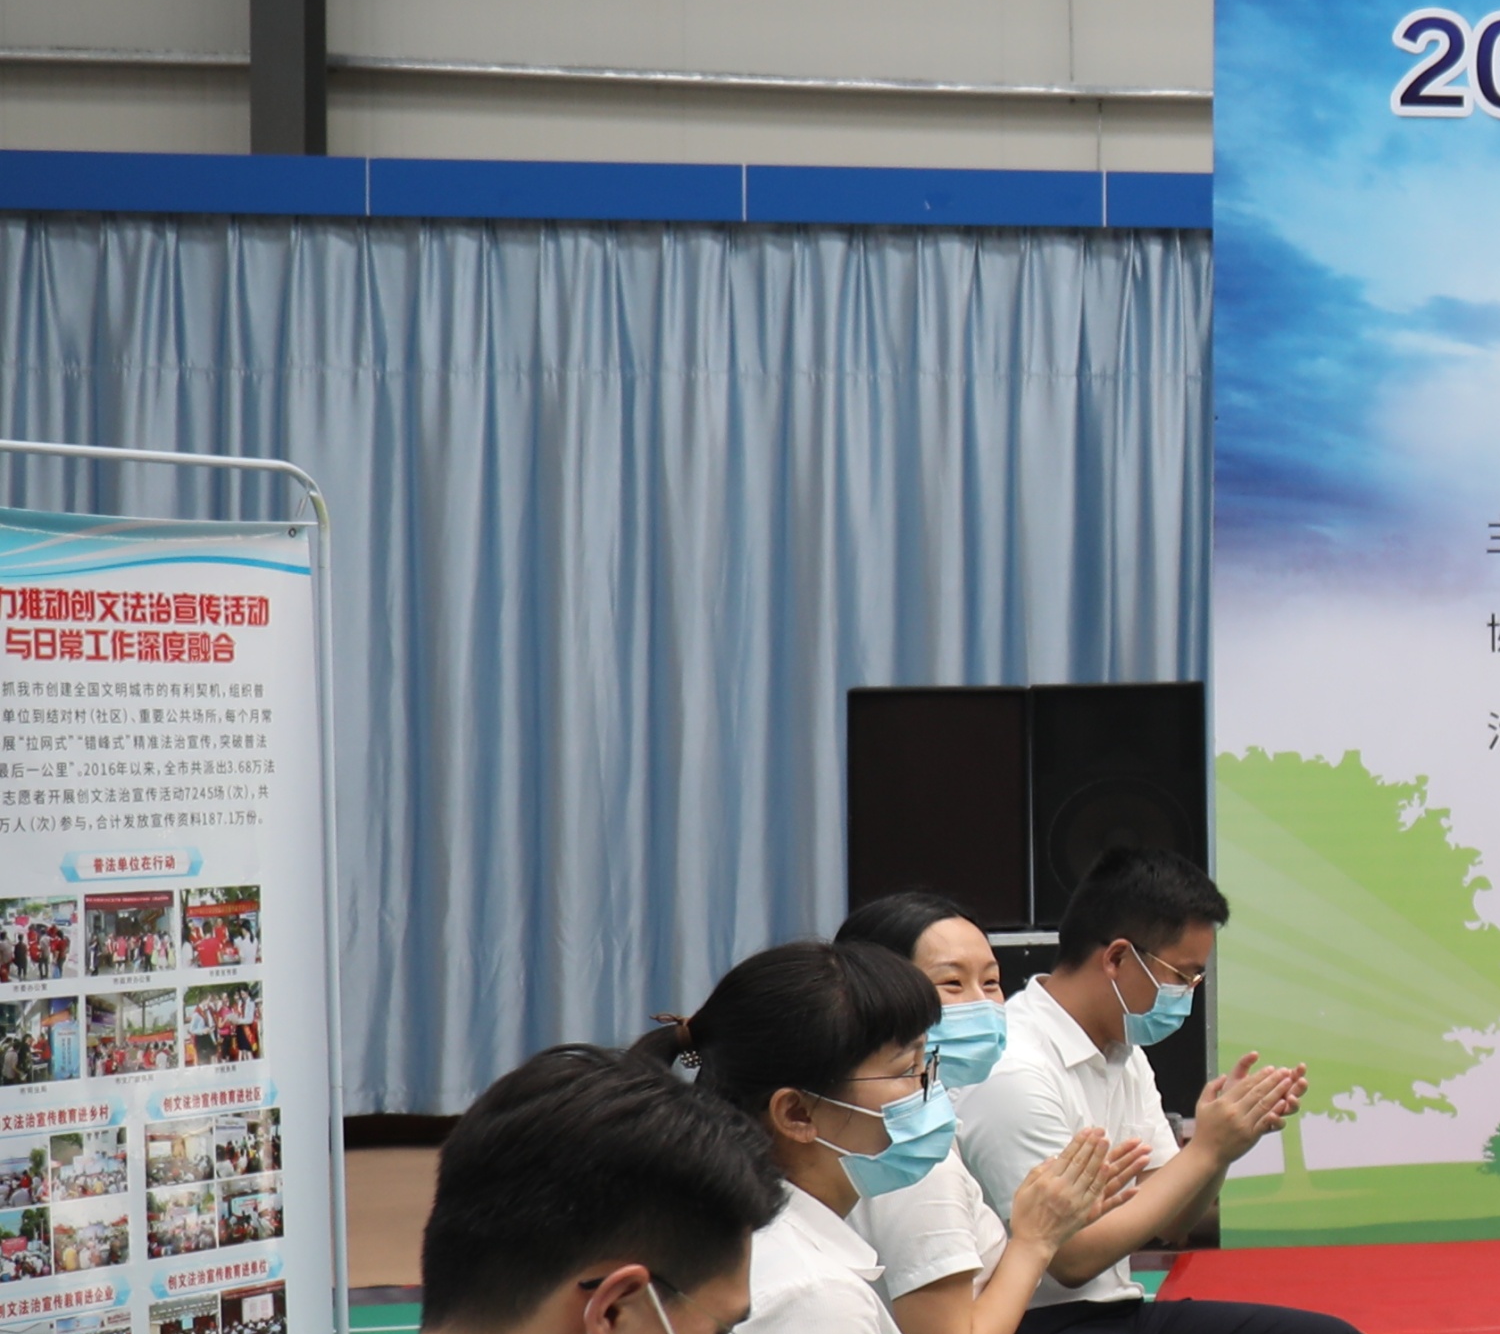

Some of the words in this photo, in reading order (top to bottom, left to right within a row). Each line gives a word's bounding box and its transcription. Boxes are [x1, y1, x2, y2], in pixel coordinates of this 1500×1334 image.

[5, 627, 236, 663] 与日常工作深度融合
[93, 854, 176, 873] 普法单位在行动
